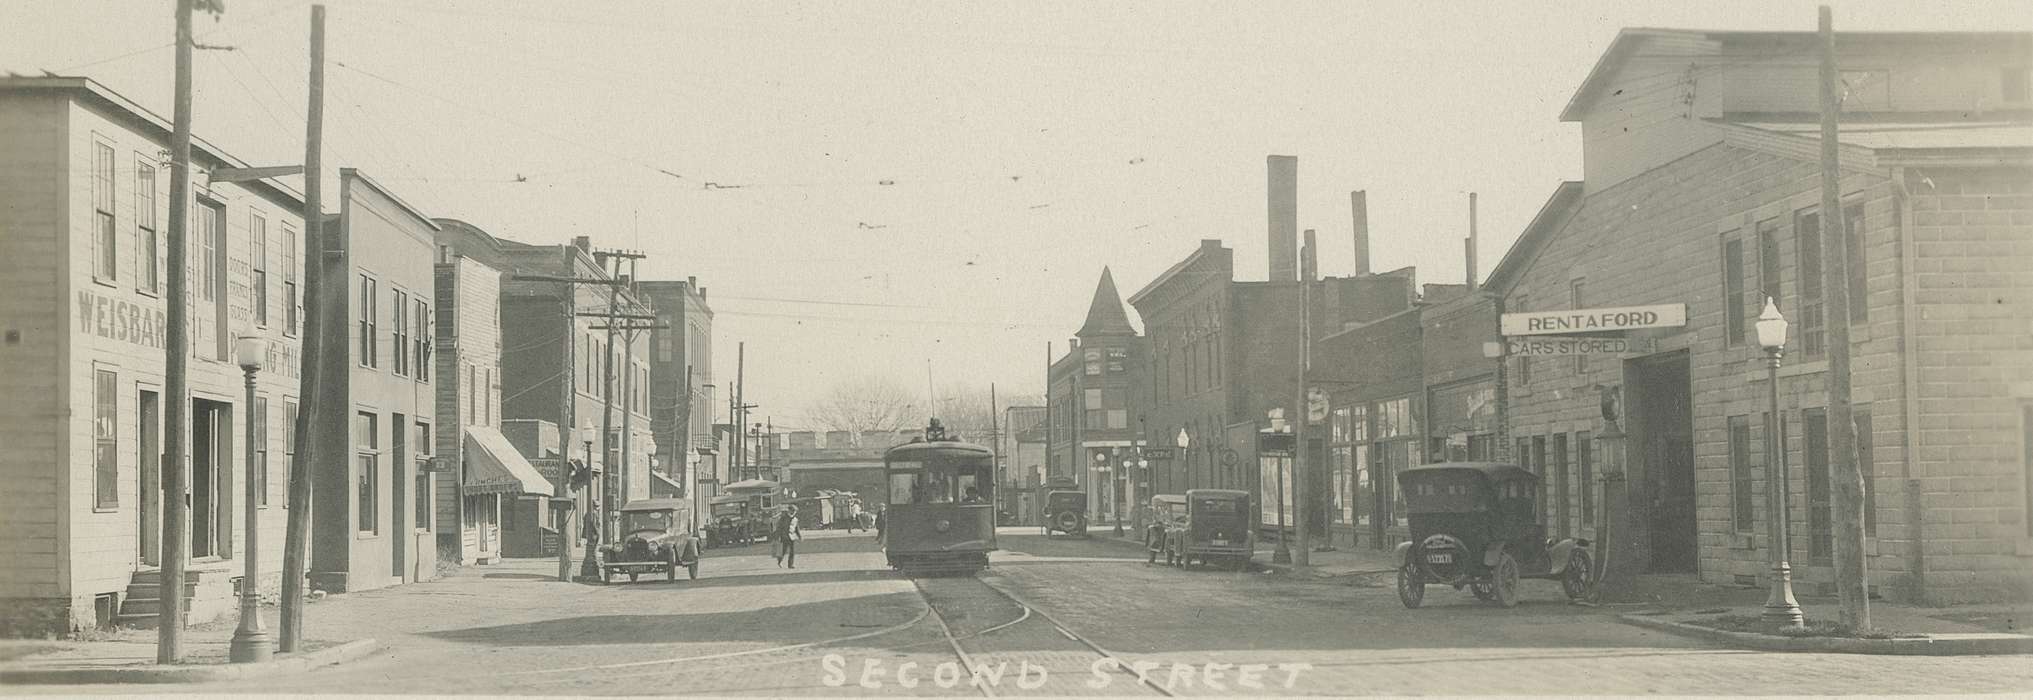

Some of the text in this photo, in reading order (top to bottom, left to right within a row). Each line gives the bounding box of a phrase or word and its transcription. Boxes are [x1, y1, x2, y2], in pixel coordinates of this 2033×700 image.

[78, 291, 166, 350] WEISBAR
[282, 342, 300, 380] MIL
[1510, 339, 1626, 355] CARS STORED
